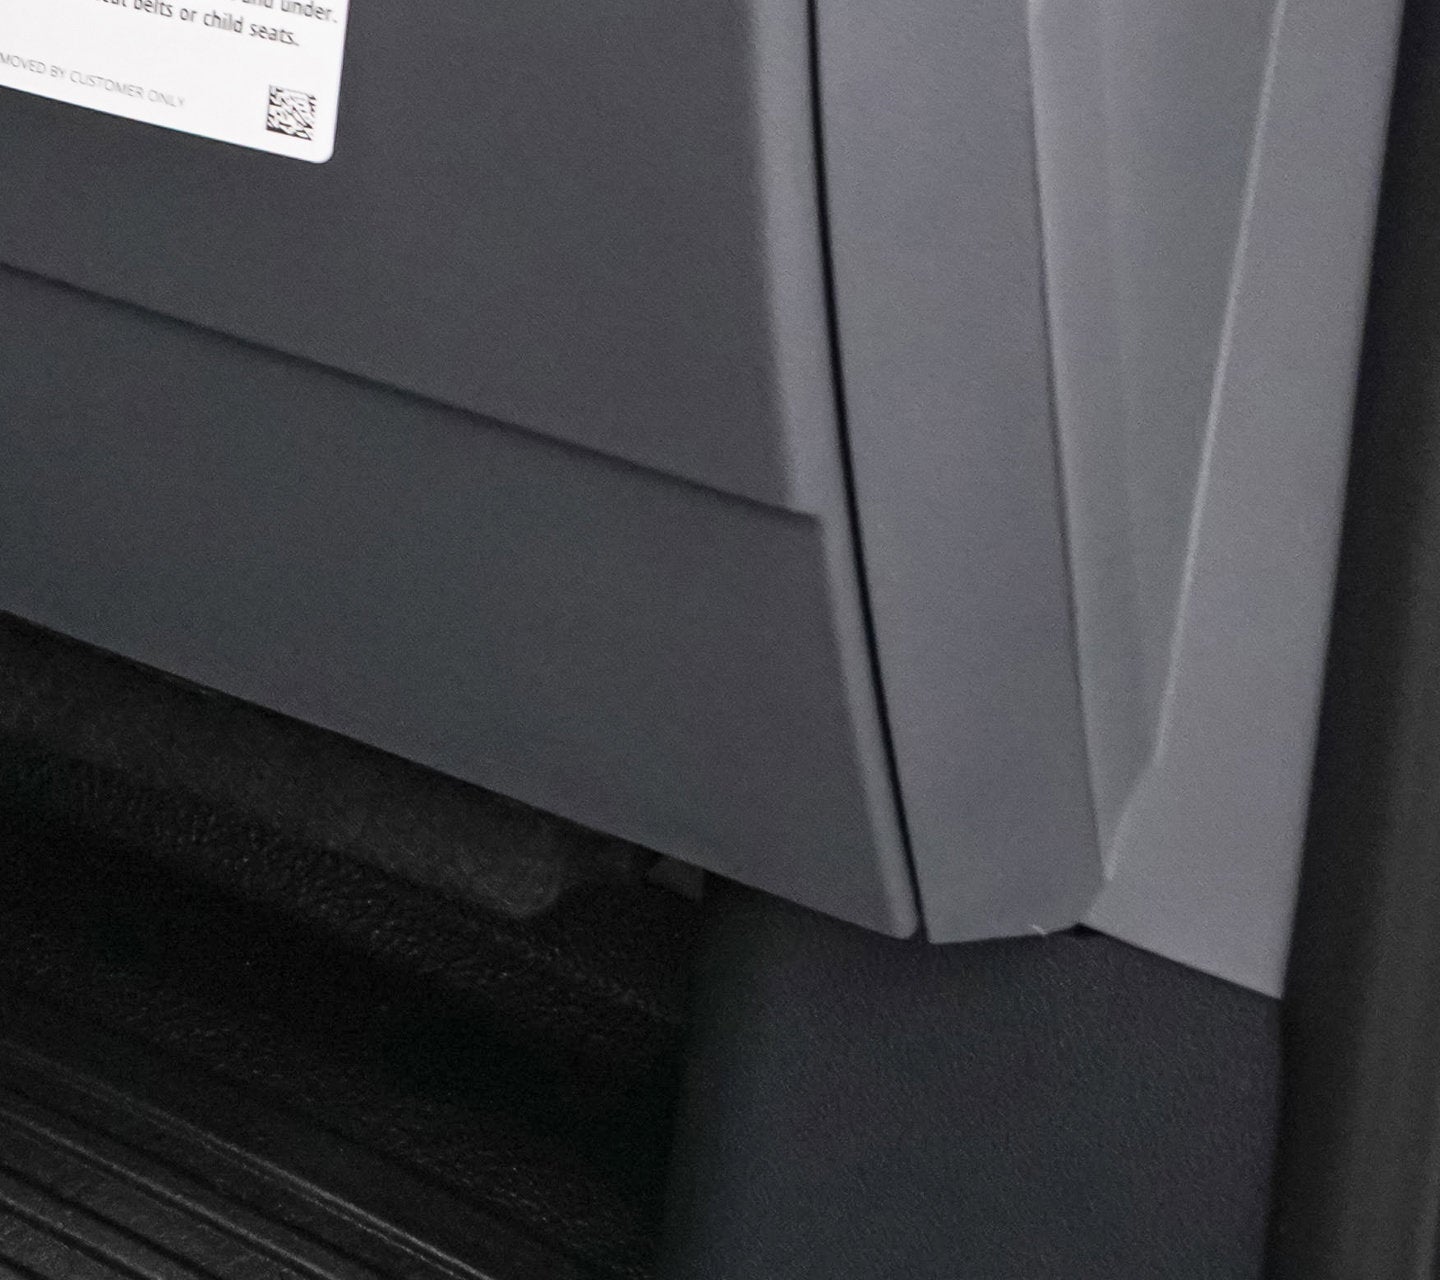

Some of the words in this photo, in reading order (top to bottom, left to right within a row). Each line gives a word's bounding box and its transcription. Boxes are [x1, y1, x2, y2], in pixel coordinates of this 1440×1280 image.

[179, 5, 198, 23] or
[203, 9, 245, 35] child
[249, 20, 300, 47] seats.
[49, 64, 66, 79] BY
[69, 69, 146, 98] CUSTOMER
[147, 89, 187, 109] ONLY
